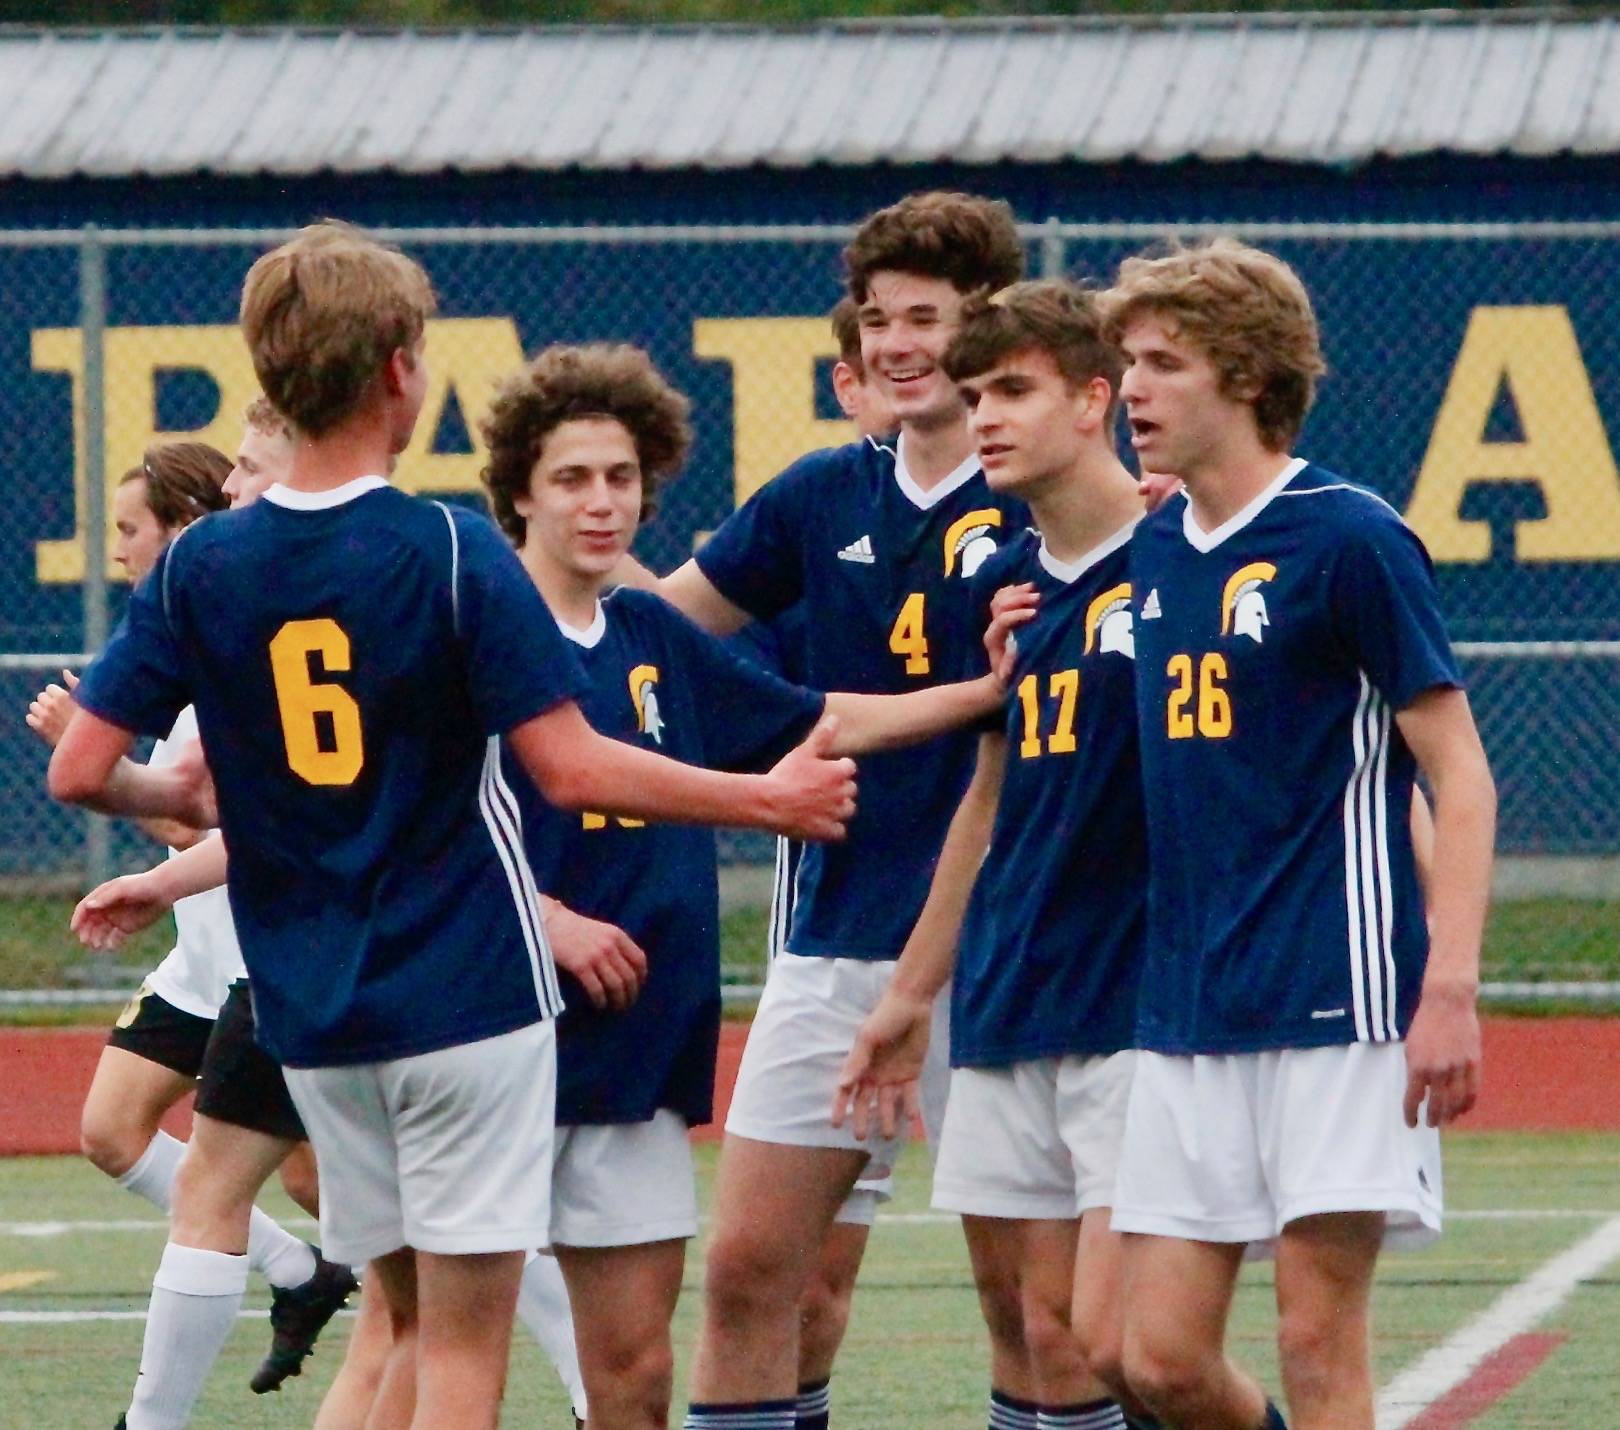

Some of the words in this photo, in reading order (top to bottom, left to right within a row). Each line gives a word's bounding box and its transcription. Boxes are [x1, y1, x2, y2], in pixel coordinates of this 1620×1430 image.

[888, 591, 931, 676] 4
[268, 617, 365, 787] 6
[1017, 668, 1080, 760] 17
[1166, 652, 1233, 740] 26
